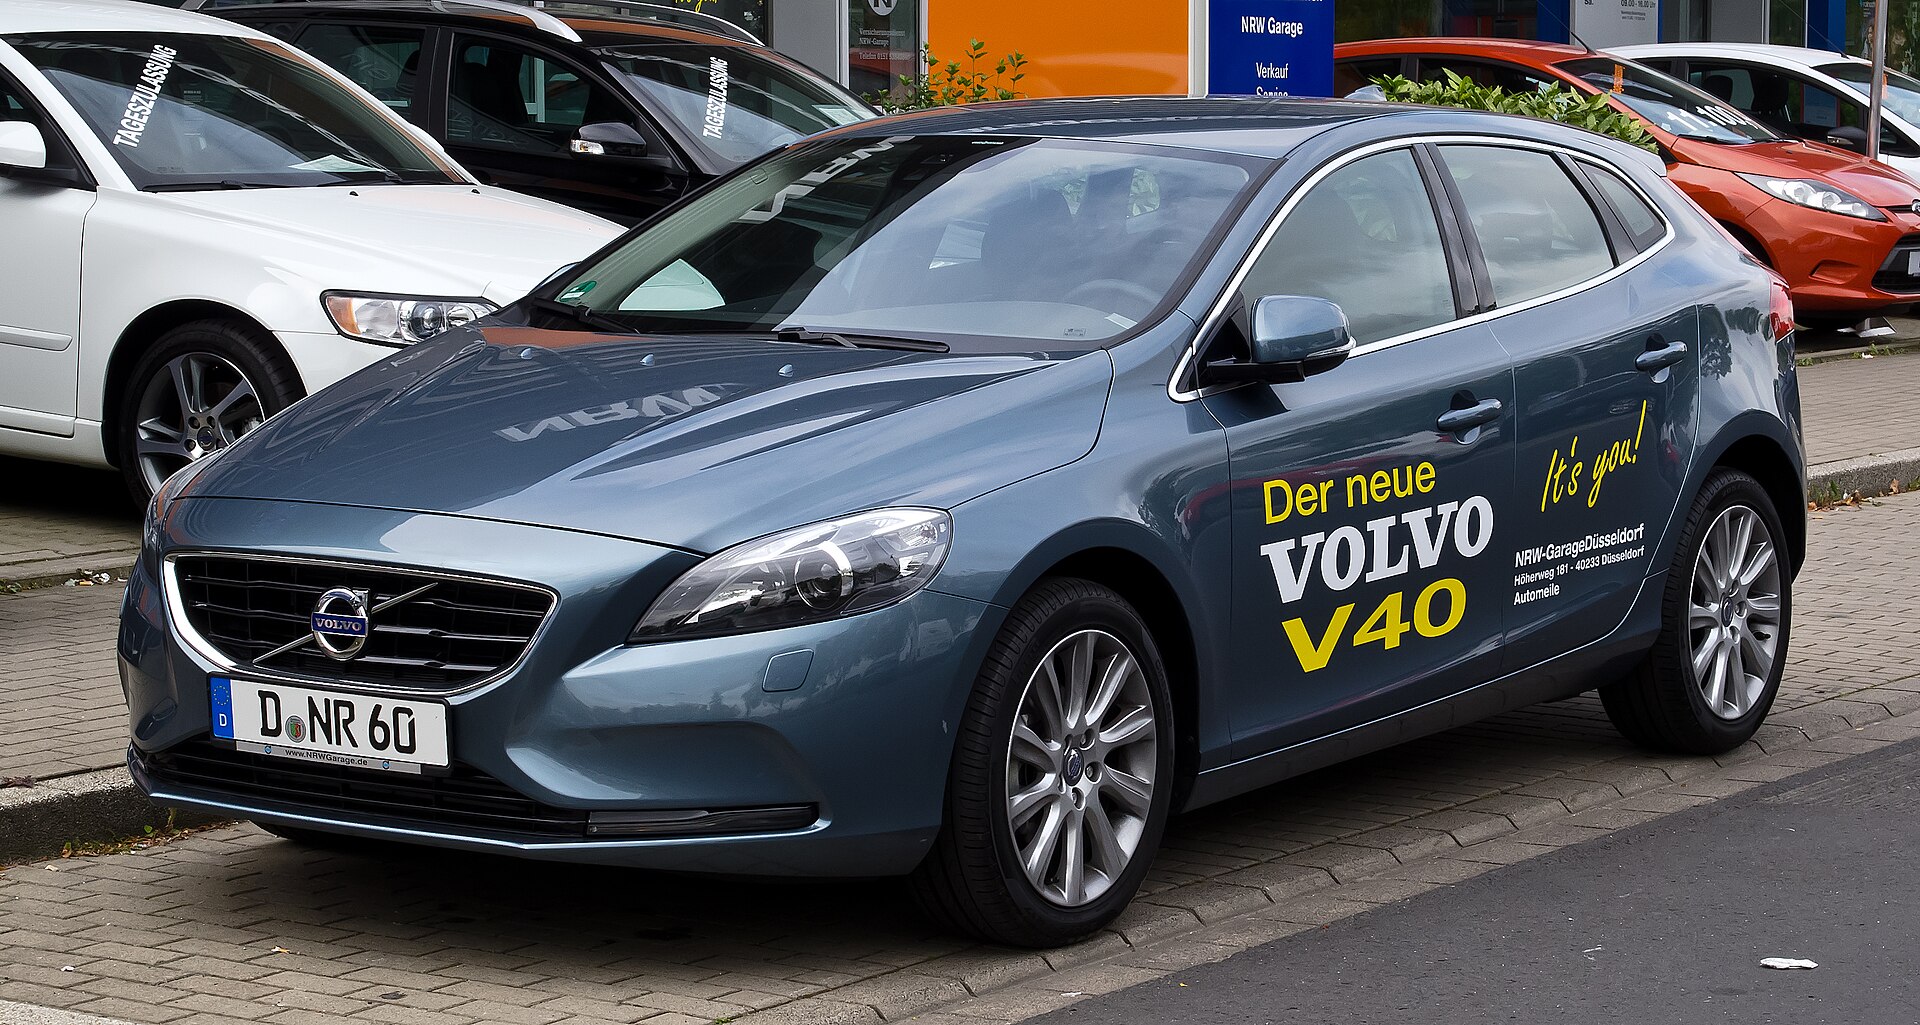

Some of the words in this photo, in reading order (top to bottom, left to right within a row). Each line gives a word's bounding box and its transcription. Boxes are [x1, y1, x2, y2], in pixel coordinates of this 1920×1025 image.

[1241, 16, 1266, 34] NRW
[1267, 17, 1303, 38] Garage
[112, 44, 178, 148] TAGESZULASSUNG
[1256, 62, 1289, 79] Verkauf
[702, 56, 728, 139] TAGESZULASSUNG
[1540, 436, 1583, 512] It's
[1587, 400, 1647, 508] you!
[1263, 478, 1334, 525] Der
[1346, 461, 1436, 508] neue
[1260, 495, 1494, 604] VOLVO
[1514, 568, 1554, 586] Höherweg
[1556, 563, 1569, 577] 181
[1575, 556, 1600, 571] 40233
[1601, 545, 1645, 565] Düsseldorf
[1513, 583, 1560, 606] Automeile
[315, 617, 363, 632] VOLVO
[1281, 578, 1467, 673] V40
[218, 714, 228, 727] D
[258, 690, 282, 737] D
[308, 696, 358, 748] NR
[369, 704, 416, 754] 60
[284, 749, 368, 766] www.NRWGarage.de
